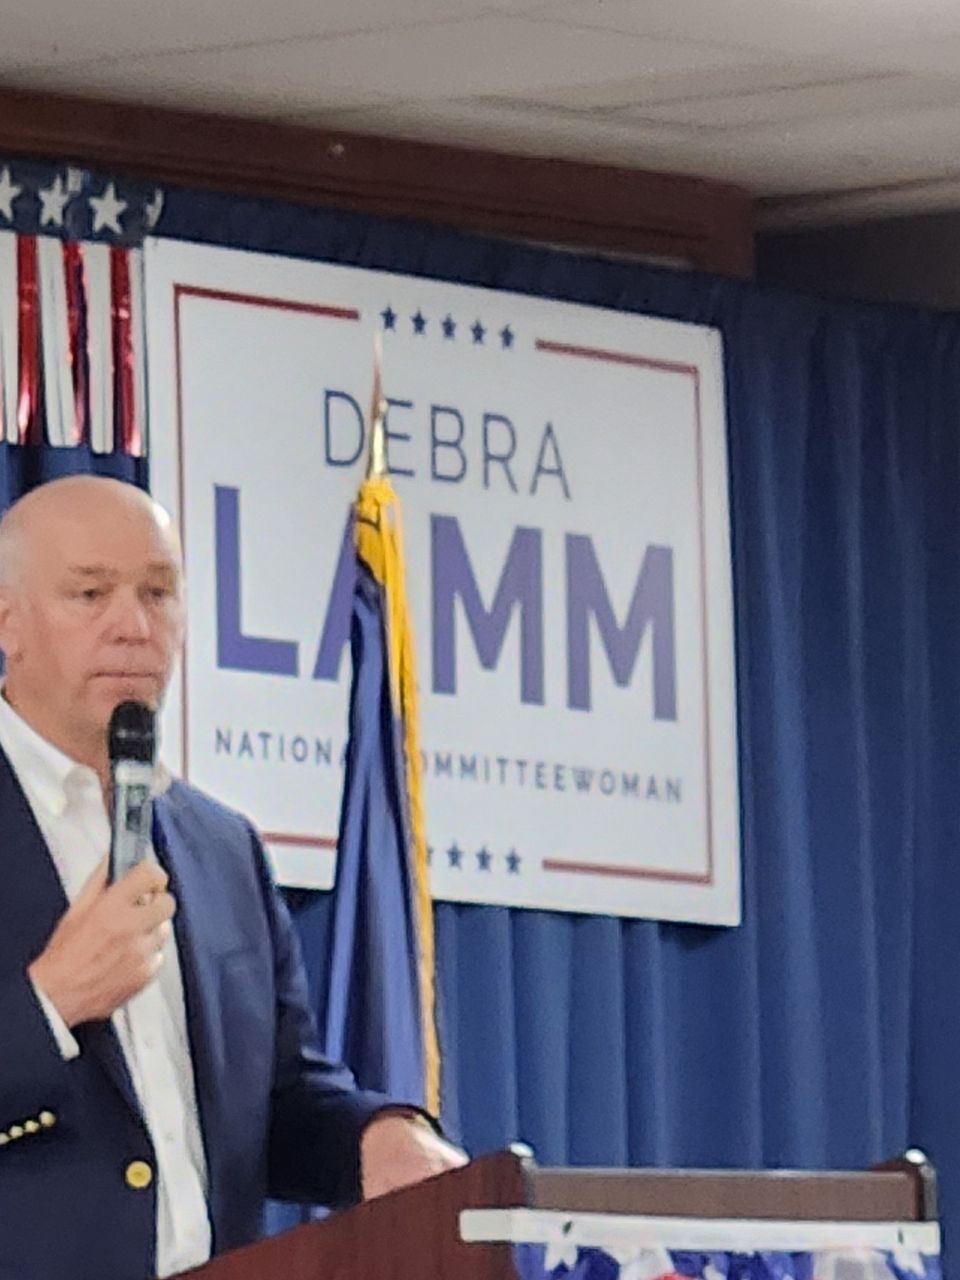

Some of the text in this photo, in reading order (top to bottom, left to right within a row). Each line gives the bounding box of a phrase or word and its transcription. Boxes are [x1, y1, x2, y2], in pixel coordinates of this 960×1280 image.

[324, 389, 571, 500] DEBRA
[215, 728, 683, 803] NATION MMITTEEWOMAN
